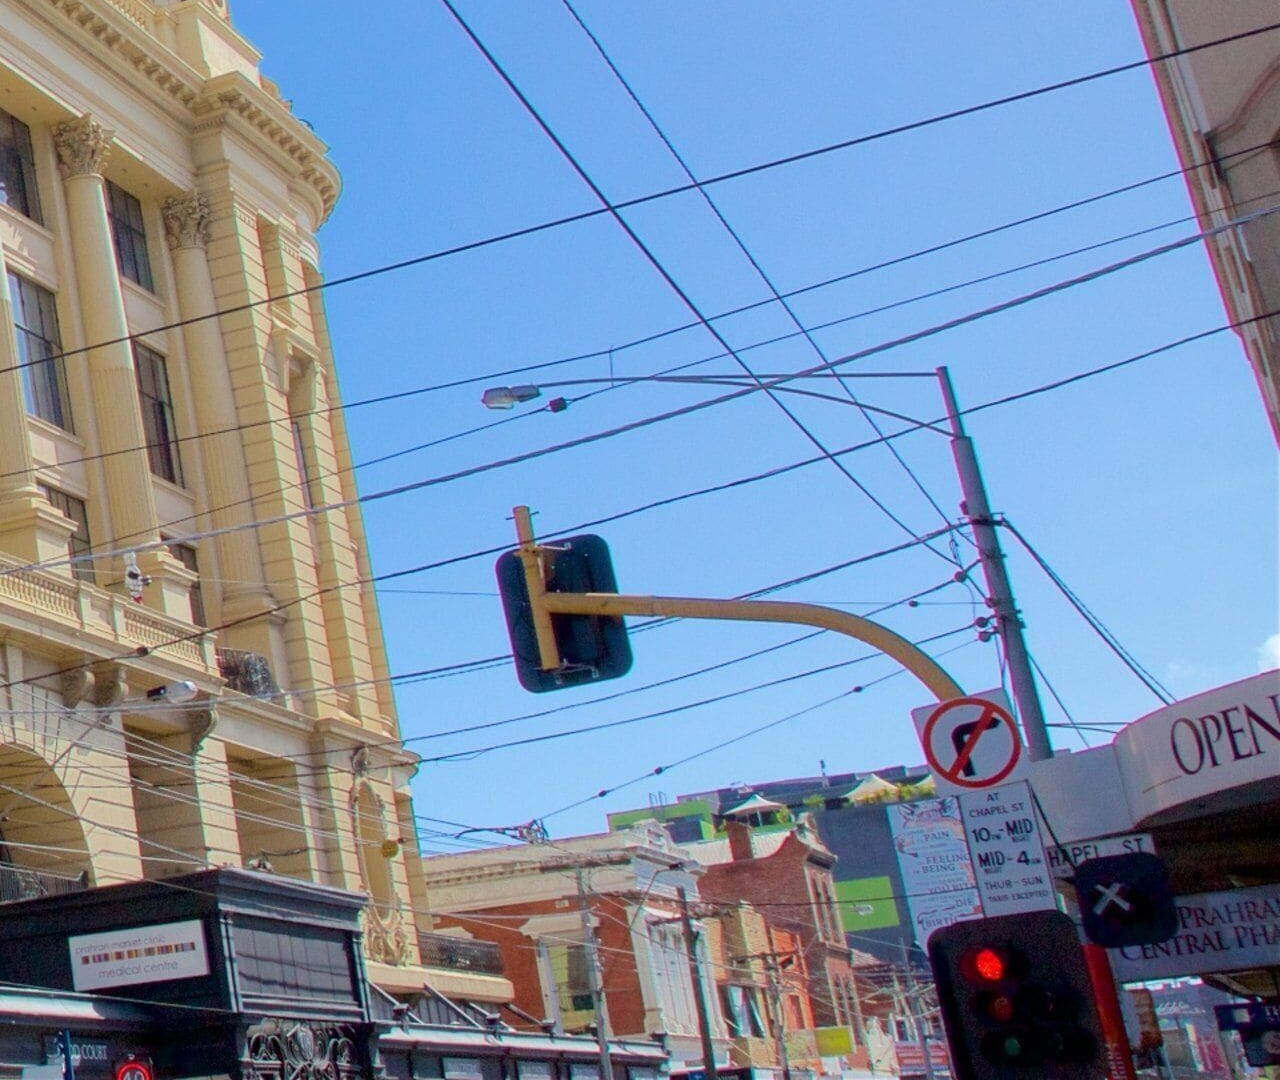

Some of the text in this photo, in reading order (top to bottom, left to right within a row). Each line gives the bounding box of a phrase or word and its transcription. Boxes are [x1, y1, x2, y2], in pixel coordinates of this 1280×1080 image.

[987, 793, 999, 801] AT
[969, 802, 1024, 818] CHAPEL ST
[1122, 838, 1143, 853] ST
[922, 864, 956, 874] BEING
[1178, 897, 1280, 930] PRAHRA
[1119, 930, 1230, 961] CENTRAL
[98, 960, 178, 978] medical centre
[81, 1044, 107, 1060] COURT
